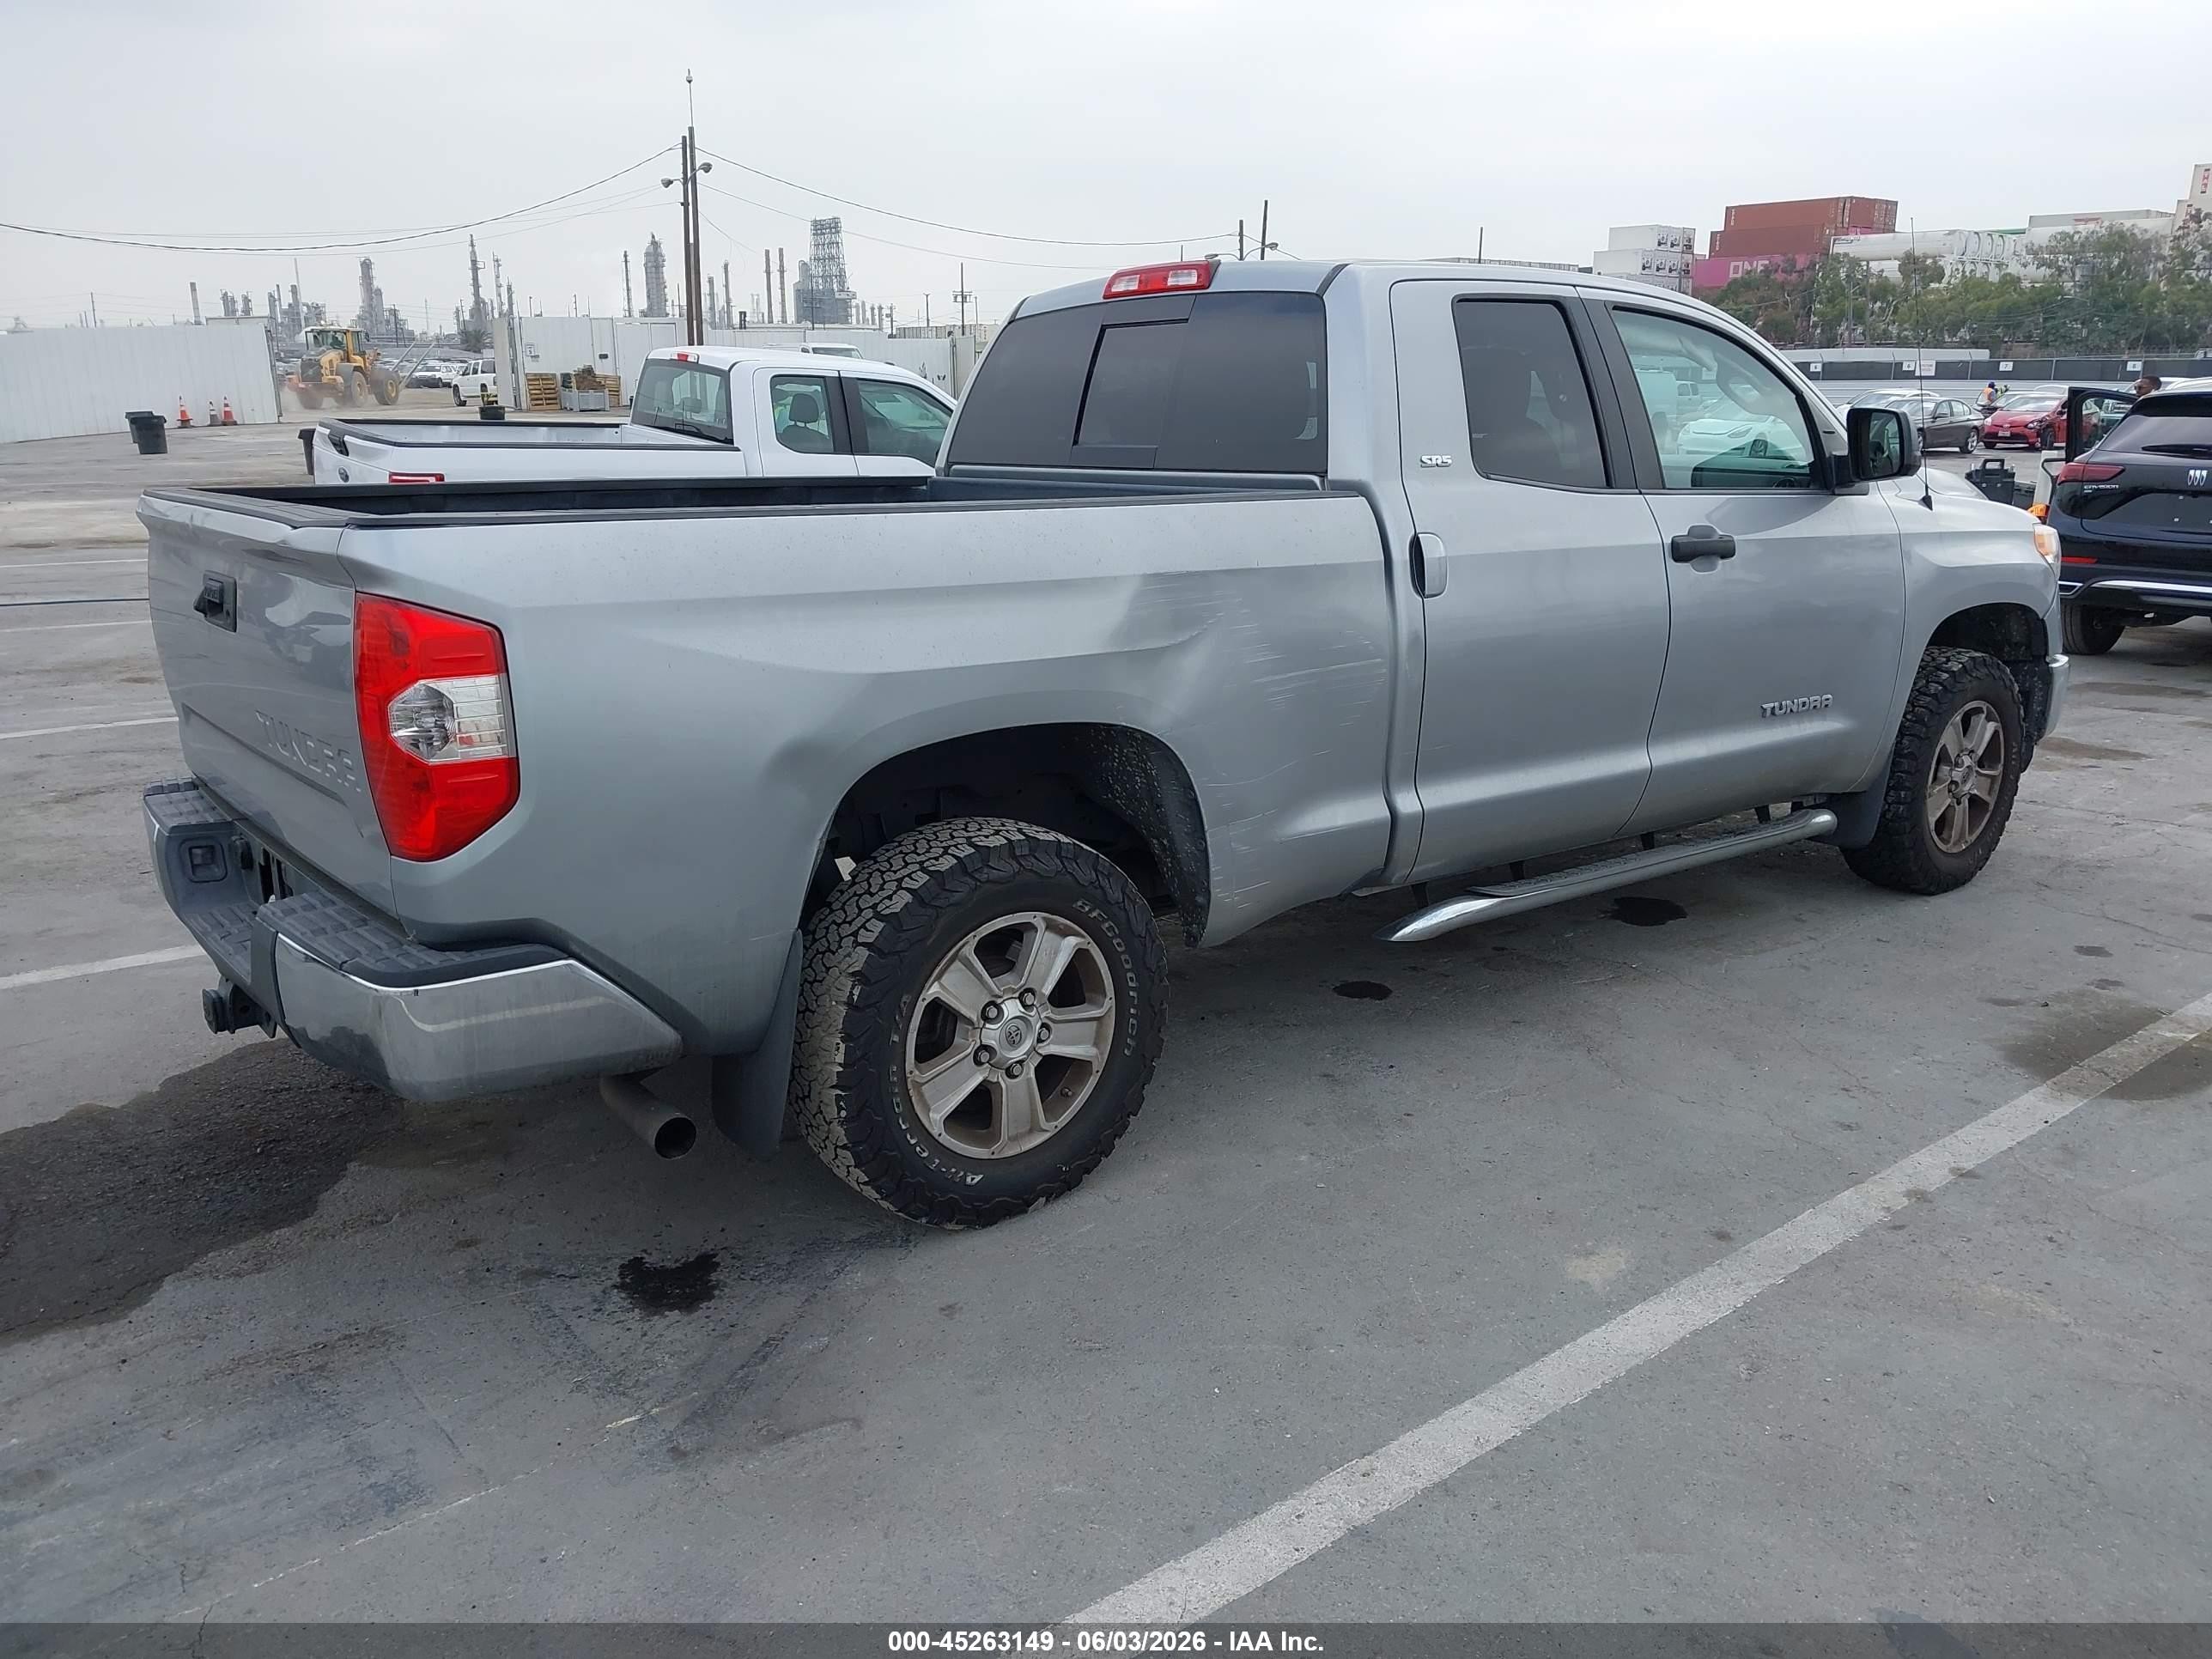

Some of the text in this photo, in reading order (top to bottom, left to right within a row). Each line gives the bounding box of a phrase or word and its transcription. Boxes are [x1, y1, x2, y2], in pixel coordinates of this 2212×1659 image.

[1420, 455, 1453, 467] SR5
[1760, 694, 1833, 718] TUNDRA
[255, 709, 362, 793] TUNDRA
[1073, 899, 1138, 1057] BFGoodrich
